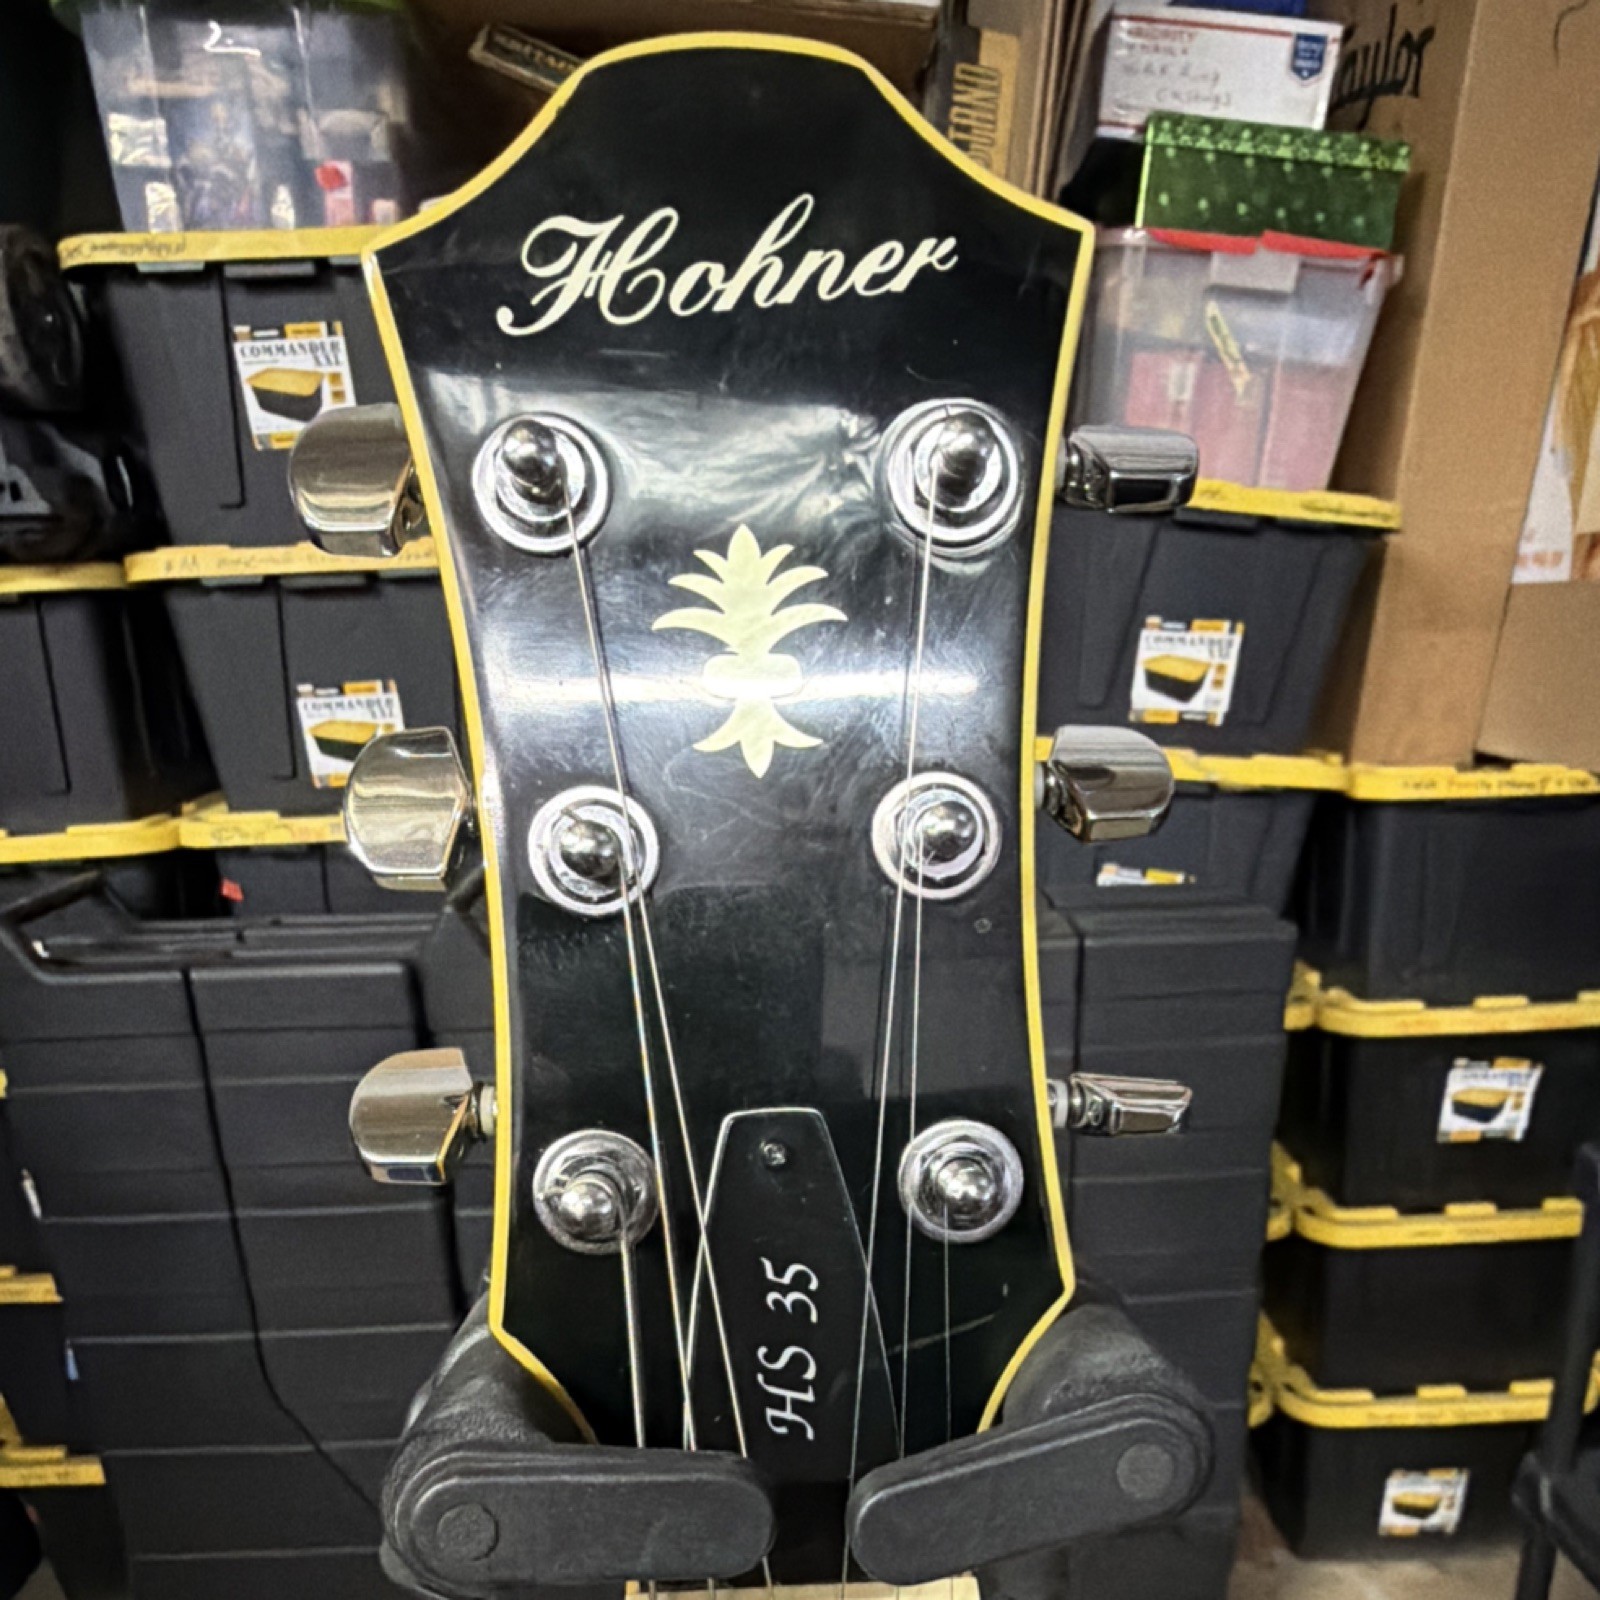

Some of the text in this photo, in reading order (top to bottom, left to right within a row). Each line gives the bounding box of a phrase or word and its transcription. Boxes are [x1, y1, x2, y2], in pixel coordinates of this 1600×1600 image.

[1328, 3, 1436, 131] aylor
[496, 193, 958, 336] Hohner
[757, 1256, 819, 1441] HS 35
